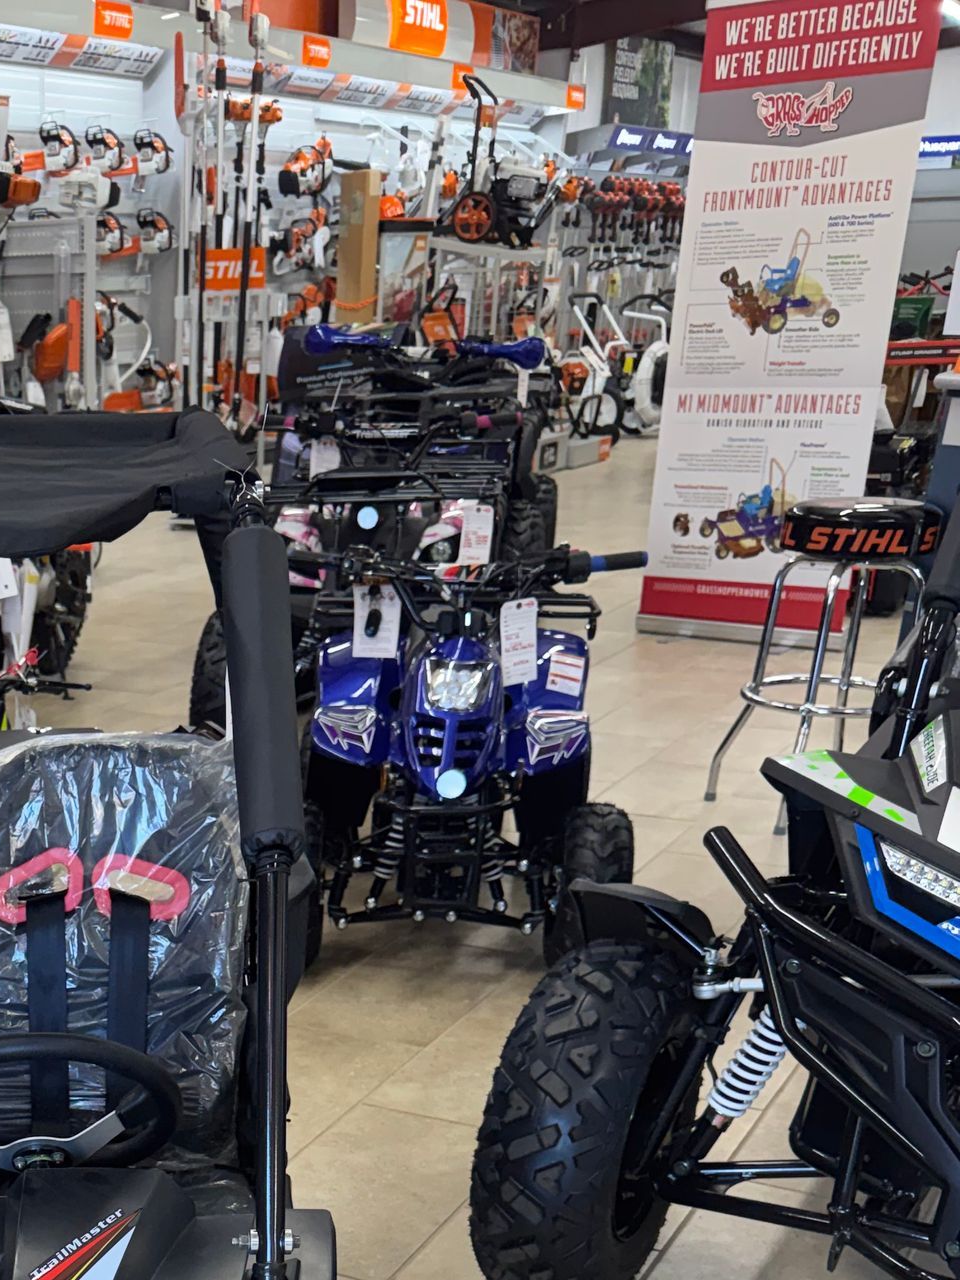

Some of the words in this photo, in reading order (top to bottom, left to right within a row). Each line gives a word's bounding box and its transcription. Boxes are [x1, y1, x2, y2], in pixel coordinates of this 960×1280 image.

[404, 0, 444, 31] STIHL
[725, 15, 773, 46] WE'RE
[777, 7, 837, 40] BETTER
[841, 0, 917, 32] BECAUSE
[715, 49, 764, 80] WE'RE
[766, 43, 811, 74] BUILT
[813, 31, 923, 69] DIFFERENTLY
[751, 155, 848, 183] CONTOUR-CUT
[801, 179, 893, 206] ADVANTAGES
[677, 394, 693, 415] M1
[775, 394, 862, 415] ADVANTAGES
[793, 420, 823, 429] FATIGUE
[806, 527, 909, 554] STIHL
